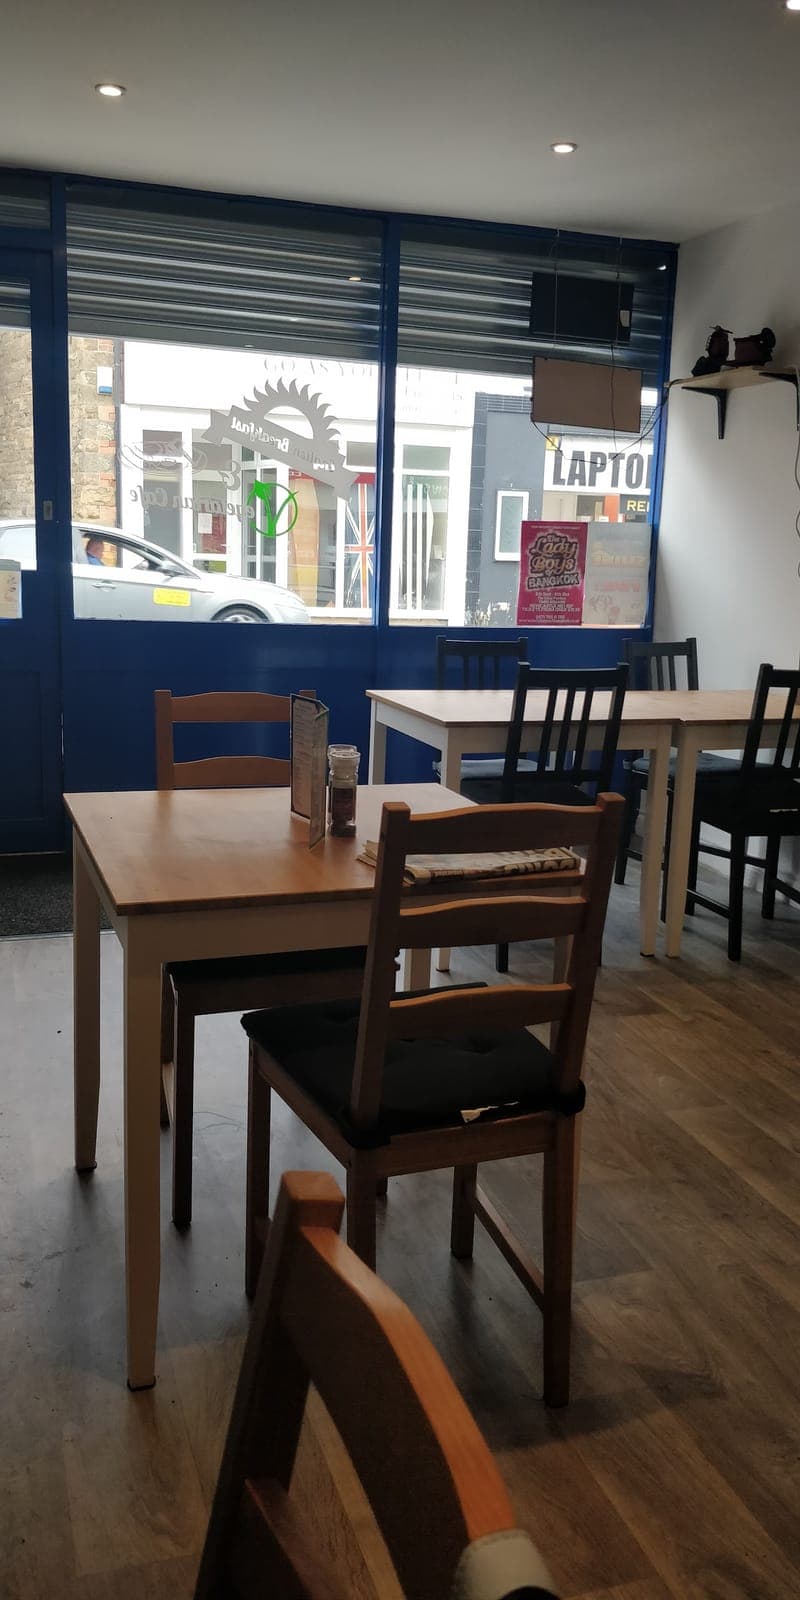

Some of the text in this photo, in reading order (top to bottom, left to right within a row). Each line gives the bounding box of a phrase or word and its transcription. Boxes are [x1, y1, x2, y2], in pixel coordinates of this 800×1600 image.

[531, 537, 577, 559] Lady
[531, 556, 574, 575] Boys
[529, 573, 579, 588] BANGKOK
